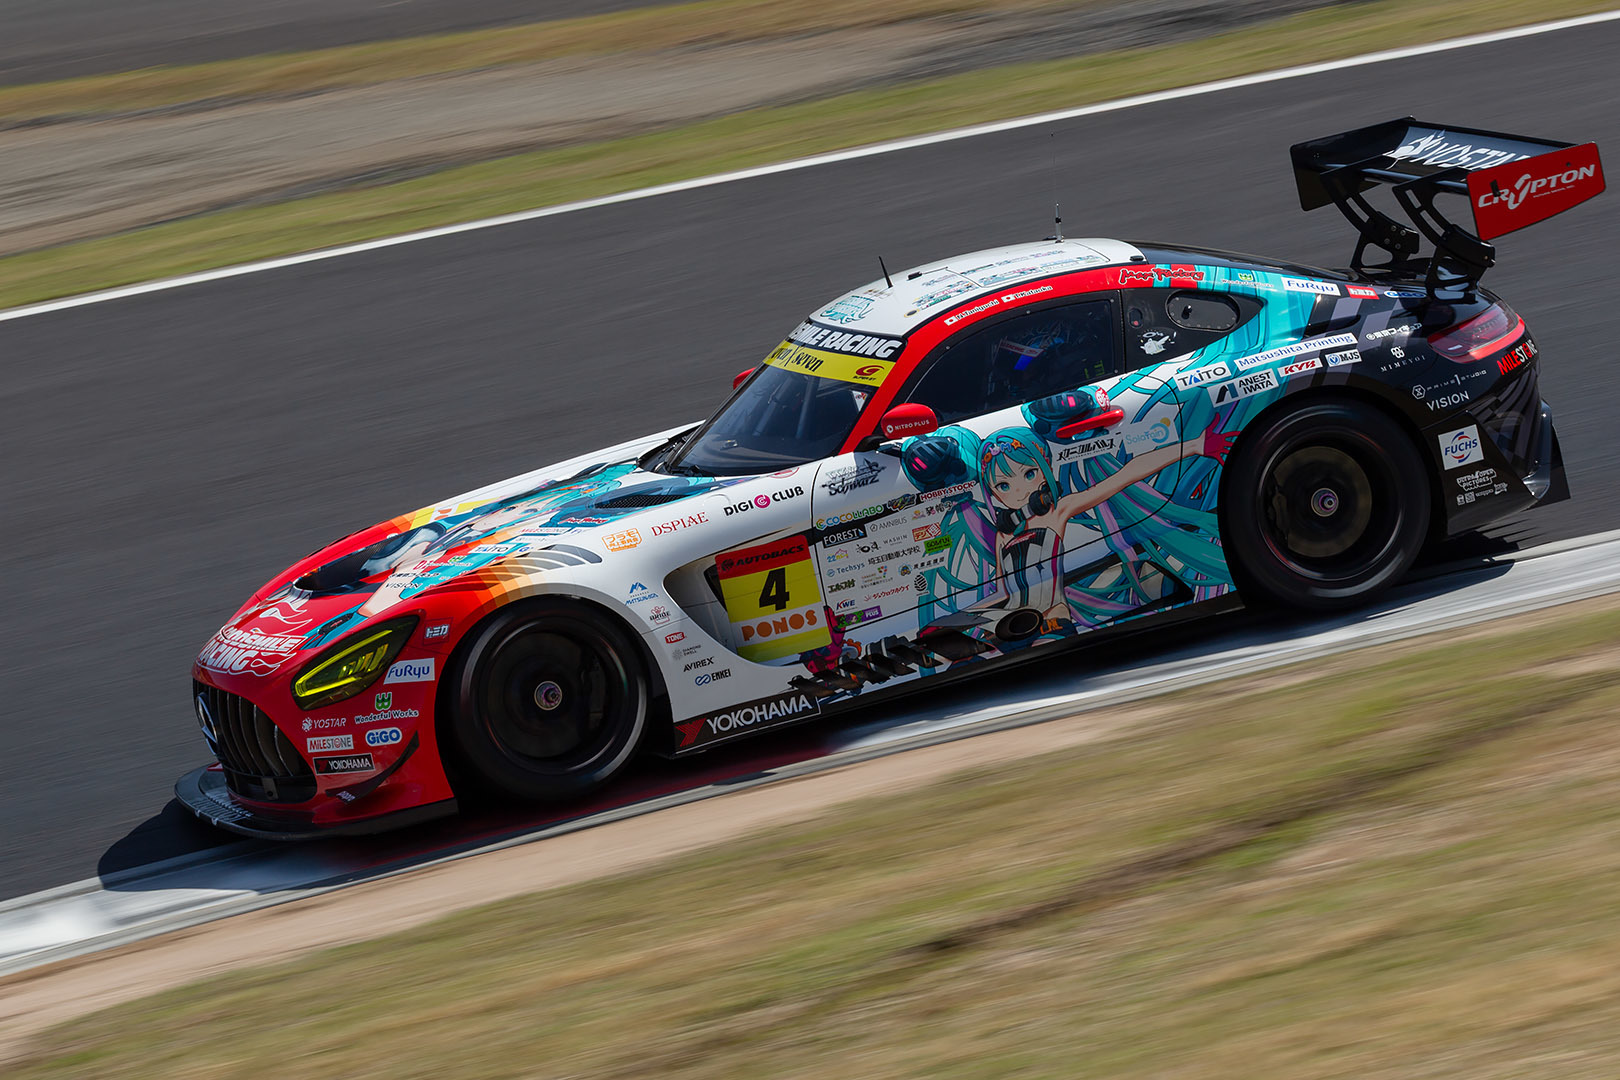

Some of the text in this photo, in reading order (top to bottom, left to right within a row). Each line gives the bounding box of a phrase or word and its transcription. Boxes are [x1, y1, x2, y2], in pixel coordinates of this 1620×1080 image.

[1478, 164, 1595, 210] CRYPTON
[1287, 280, 1334, 292] FuRyu
[819, 330, 902, 358] RACING
[1239, 336, 1353, 366] Matsushita Printing
[1341, 351, 1360, 362] MJS
[1284, 360, 1316, 375] KYB
[1178, 366, 1227, 387] TAITO
[1238, 372, 1271, 388] ANEST
[1243, 380, 1273, 395] IWATA
[1426, 390, 1470, 411] VISION
[894, 419, 930, 431] NITRO PLUS
[1444, 438, 1478, 456] FUCHS
[920, 481, 975, 502] HOBBY STOCK
[724, 486, 804, 516] DIGI CLUB
[651, 512, 709, 537] DSPIAE
[879, 517, 907, 530] AMNIBUS
[823, 528, 858, 544] FOREST
[736, 544, 804, 566] AUTOBACS
[837, 563, 865, 574] Techsys
[759, 567, 790, 611] 4
[836, 599, 856, 610] KWE
[426, 625, 449, 638] トミカ
[742, 609, 817, 641] PONOS
[667, 632, 684, 642] TONE
[388, 664, 430, 679] FuRyu
[683, 656, 714, 672] AVIREX
[711, 669, 731, 681] ENKEI
[355, 709, 419, 724] Wonderful Works
[707, 695, 812, 734] YOKOHAMA
[313, 717, 347, 729] YOSTAR
[309, 736, 352, 750] MILESTONE
[366, 729, 401, 745] GiGO
[328, 757, 371, 770] YOKOHAMA
